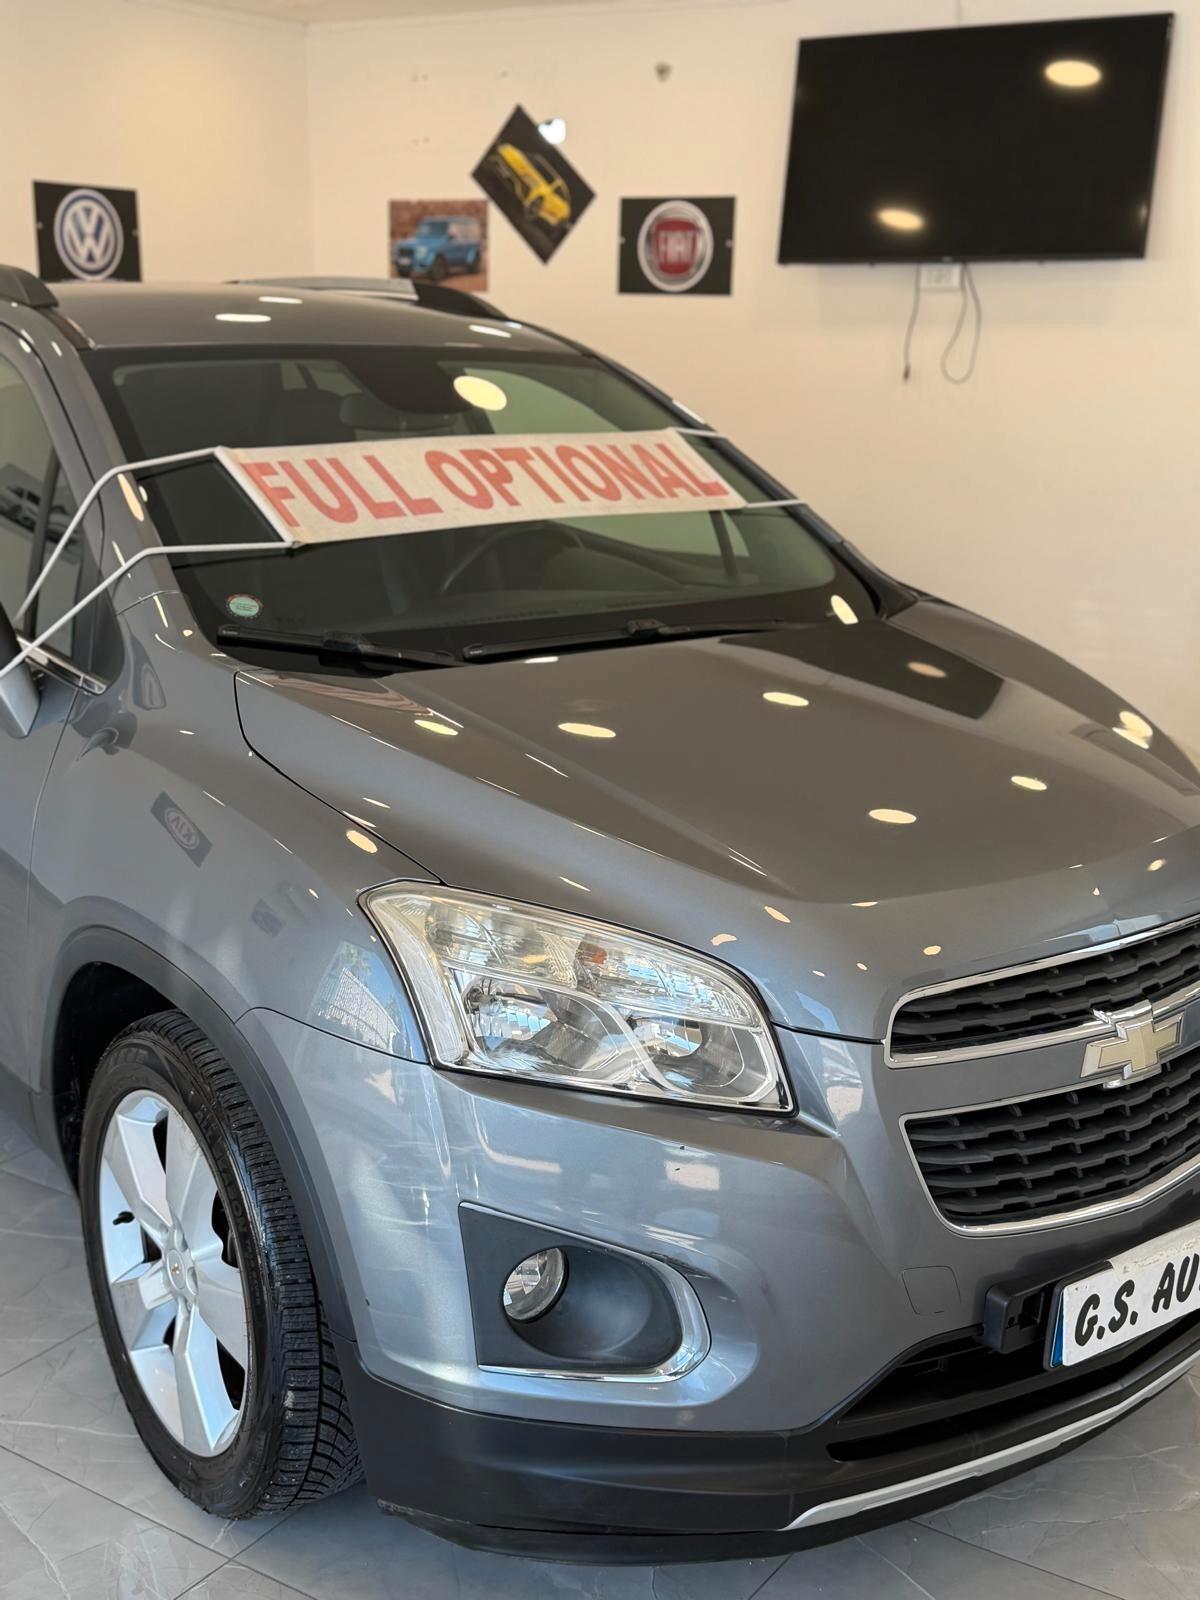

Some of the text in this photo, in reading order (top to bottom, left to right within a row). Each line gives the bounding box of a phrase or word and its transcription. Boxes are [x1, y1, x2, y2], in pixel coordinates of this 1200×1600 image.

[239, 443, 730, 527] FULL OPTIONAL
[1074, 1252, 1200, 1346] G.S. AU
